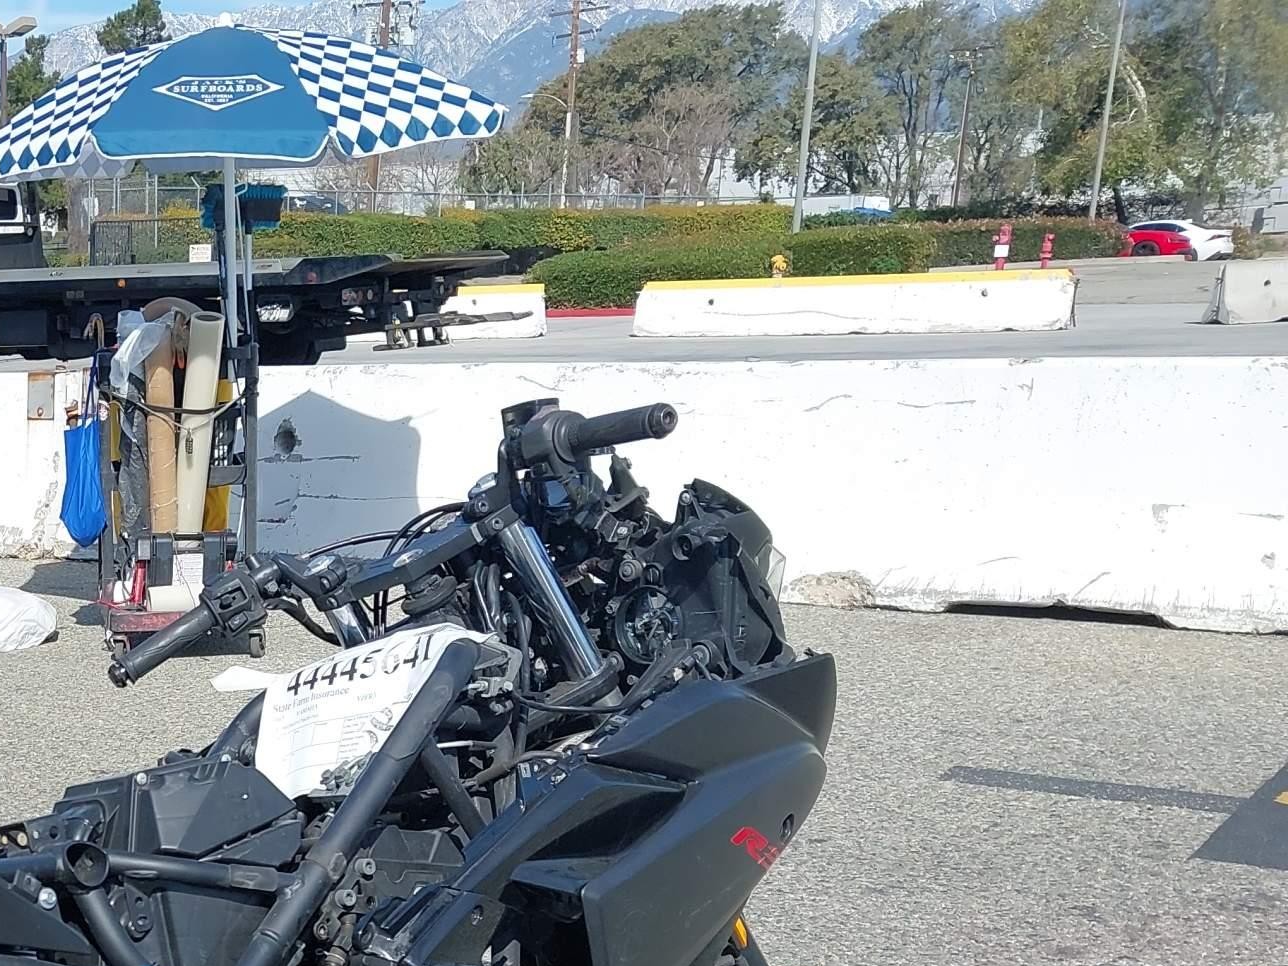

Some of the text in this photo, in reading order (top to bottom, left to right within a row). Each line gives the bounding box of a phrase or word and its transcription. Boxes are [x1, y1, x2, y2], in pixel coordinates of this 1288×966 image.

[172, 83, 263, 93] SURFBOARDS
[272, 702, 291, 713] State
[291, 696, 310, 710] Farm
[310, 687, 350, 702] Insurance
